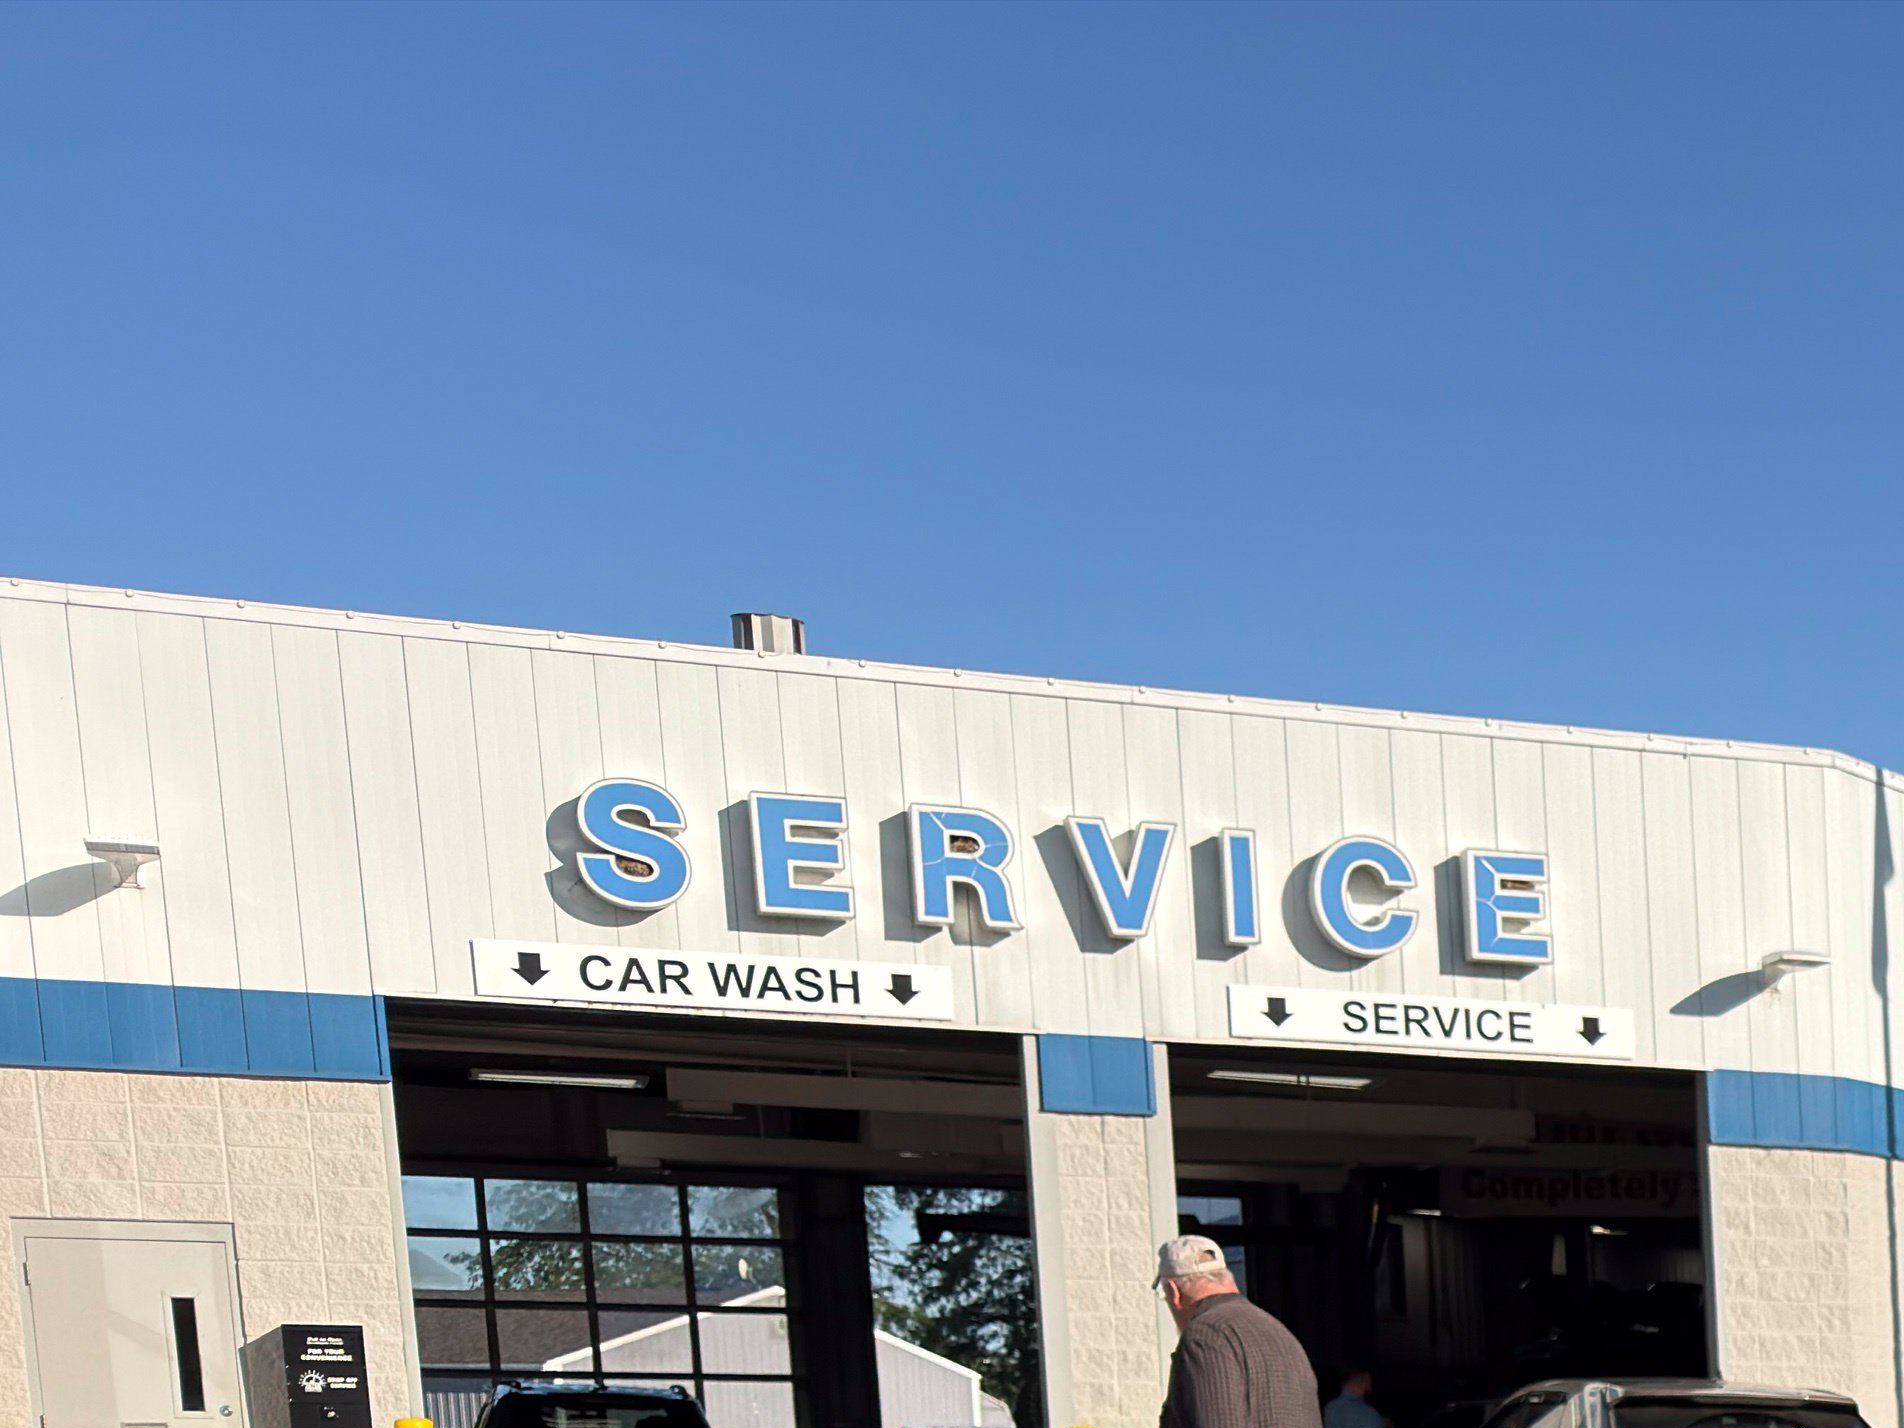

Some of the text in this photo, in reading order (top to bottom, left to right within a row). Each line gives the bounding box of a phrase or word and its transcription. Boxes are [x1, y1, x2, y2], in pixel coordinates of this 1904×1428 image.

[576, 777, 1555, 966] SERVICE
[579, 954, 861, 1004] CAR WASH
[1343, 1000, 1534, 1044] SERVICE
[1461, 1168, 1682, 1208] Completely
